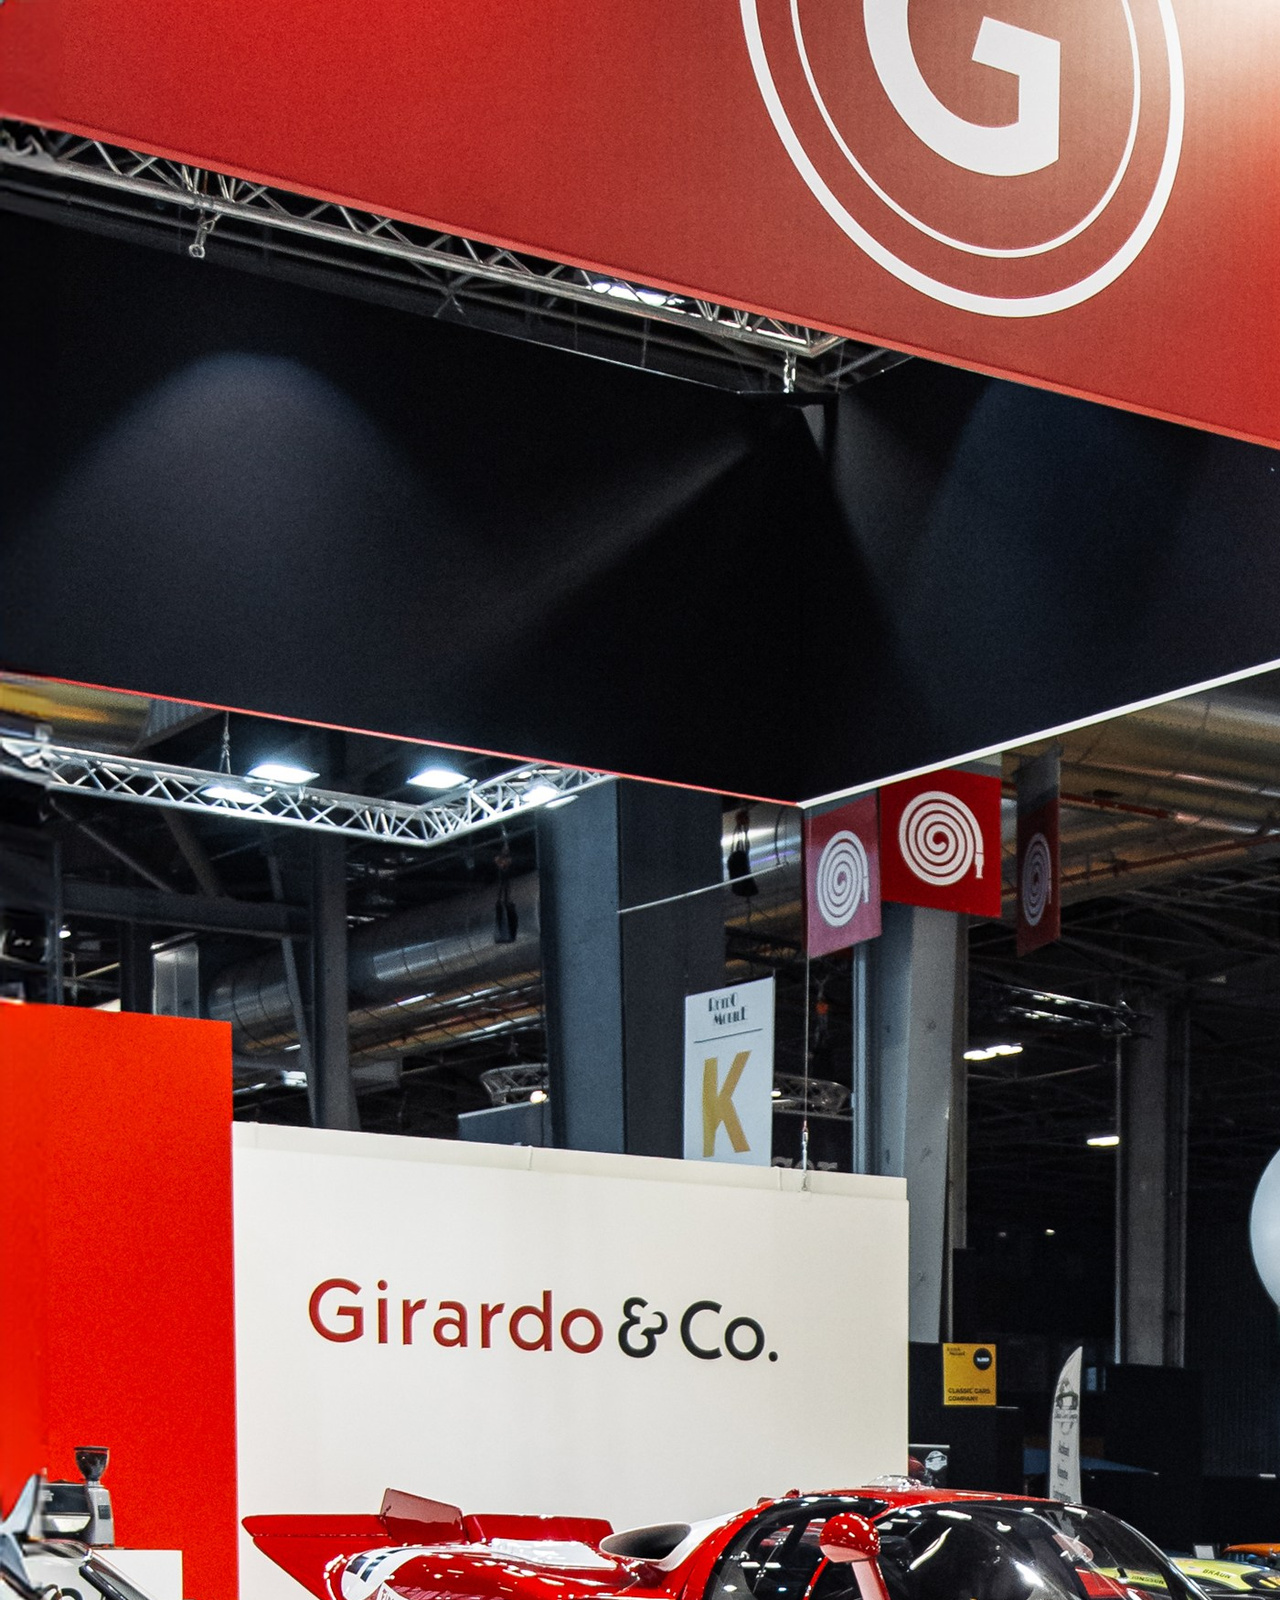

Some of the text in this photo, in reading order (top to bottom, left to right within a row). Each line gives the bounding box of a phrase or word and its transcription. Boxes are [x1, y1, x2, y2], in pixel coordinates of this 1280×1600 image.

[863, 0, 1061, 177] G
[702, 1050, 752, 1158] K
[307, 1277, 779, 1363] Girardo & Co.
[1202, 1568, 1231, 1579] BRAUN
